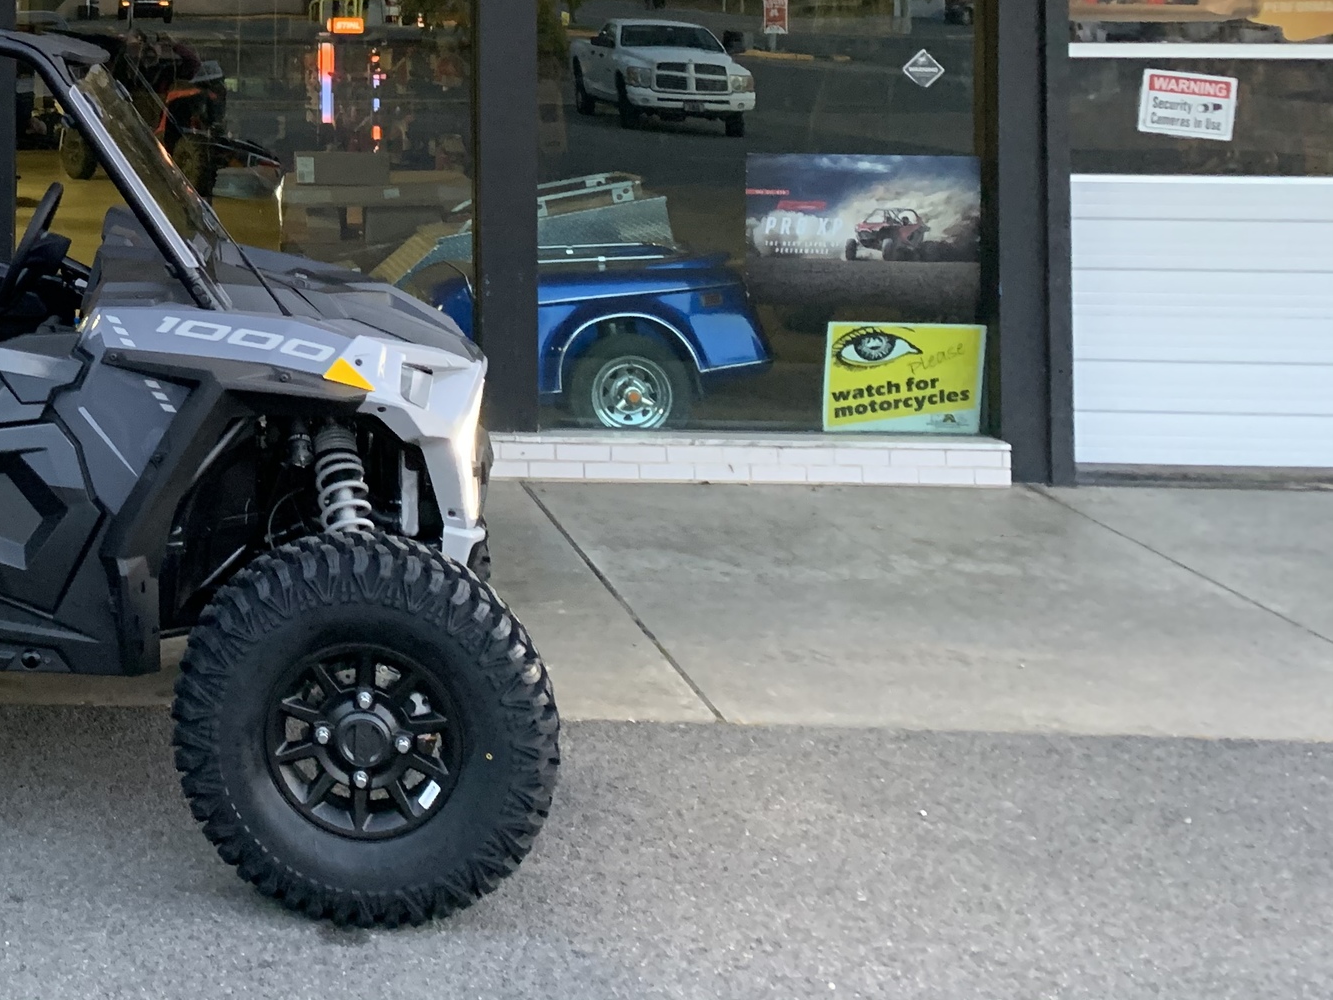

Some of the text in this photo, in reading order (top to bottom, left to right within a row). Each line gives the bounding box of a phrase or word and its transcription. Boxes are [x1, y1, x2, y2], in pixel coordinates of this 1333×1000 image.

[1153, 76, 1227, 97] WARNING
[1152, 96, 1193, 115] Security
[1150, 111, 1222, 131] Cameras In Use
[765, 216, 844, 236] PRO XP
[155, 315, 337, 363] 1000
[906, 341, 965, 375] please
[831, 376, 940, 403] watch for
[834, 388, 971, 420] motorcycles
